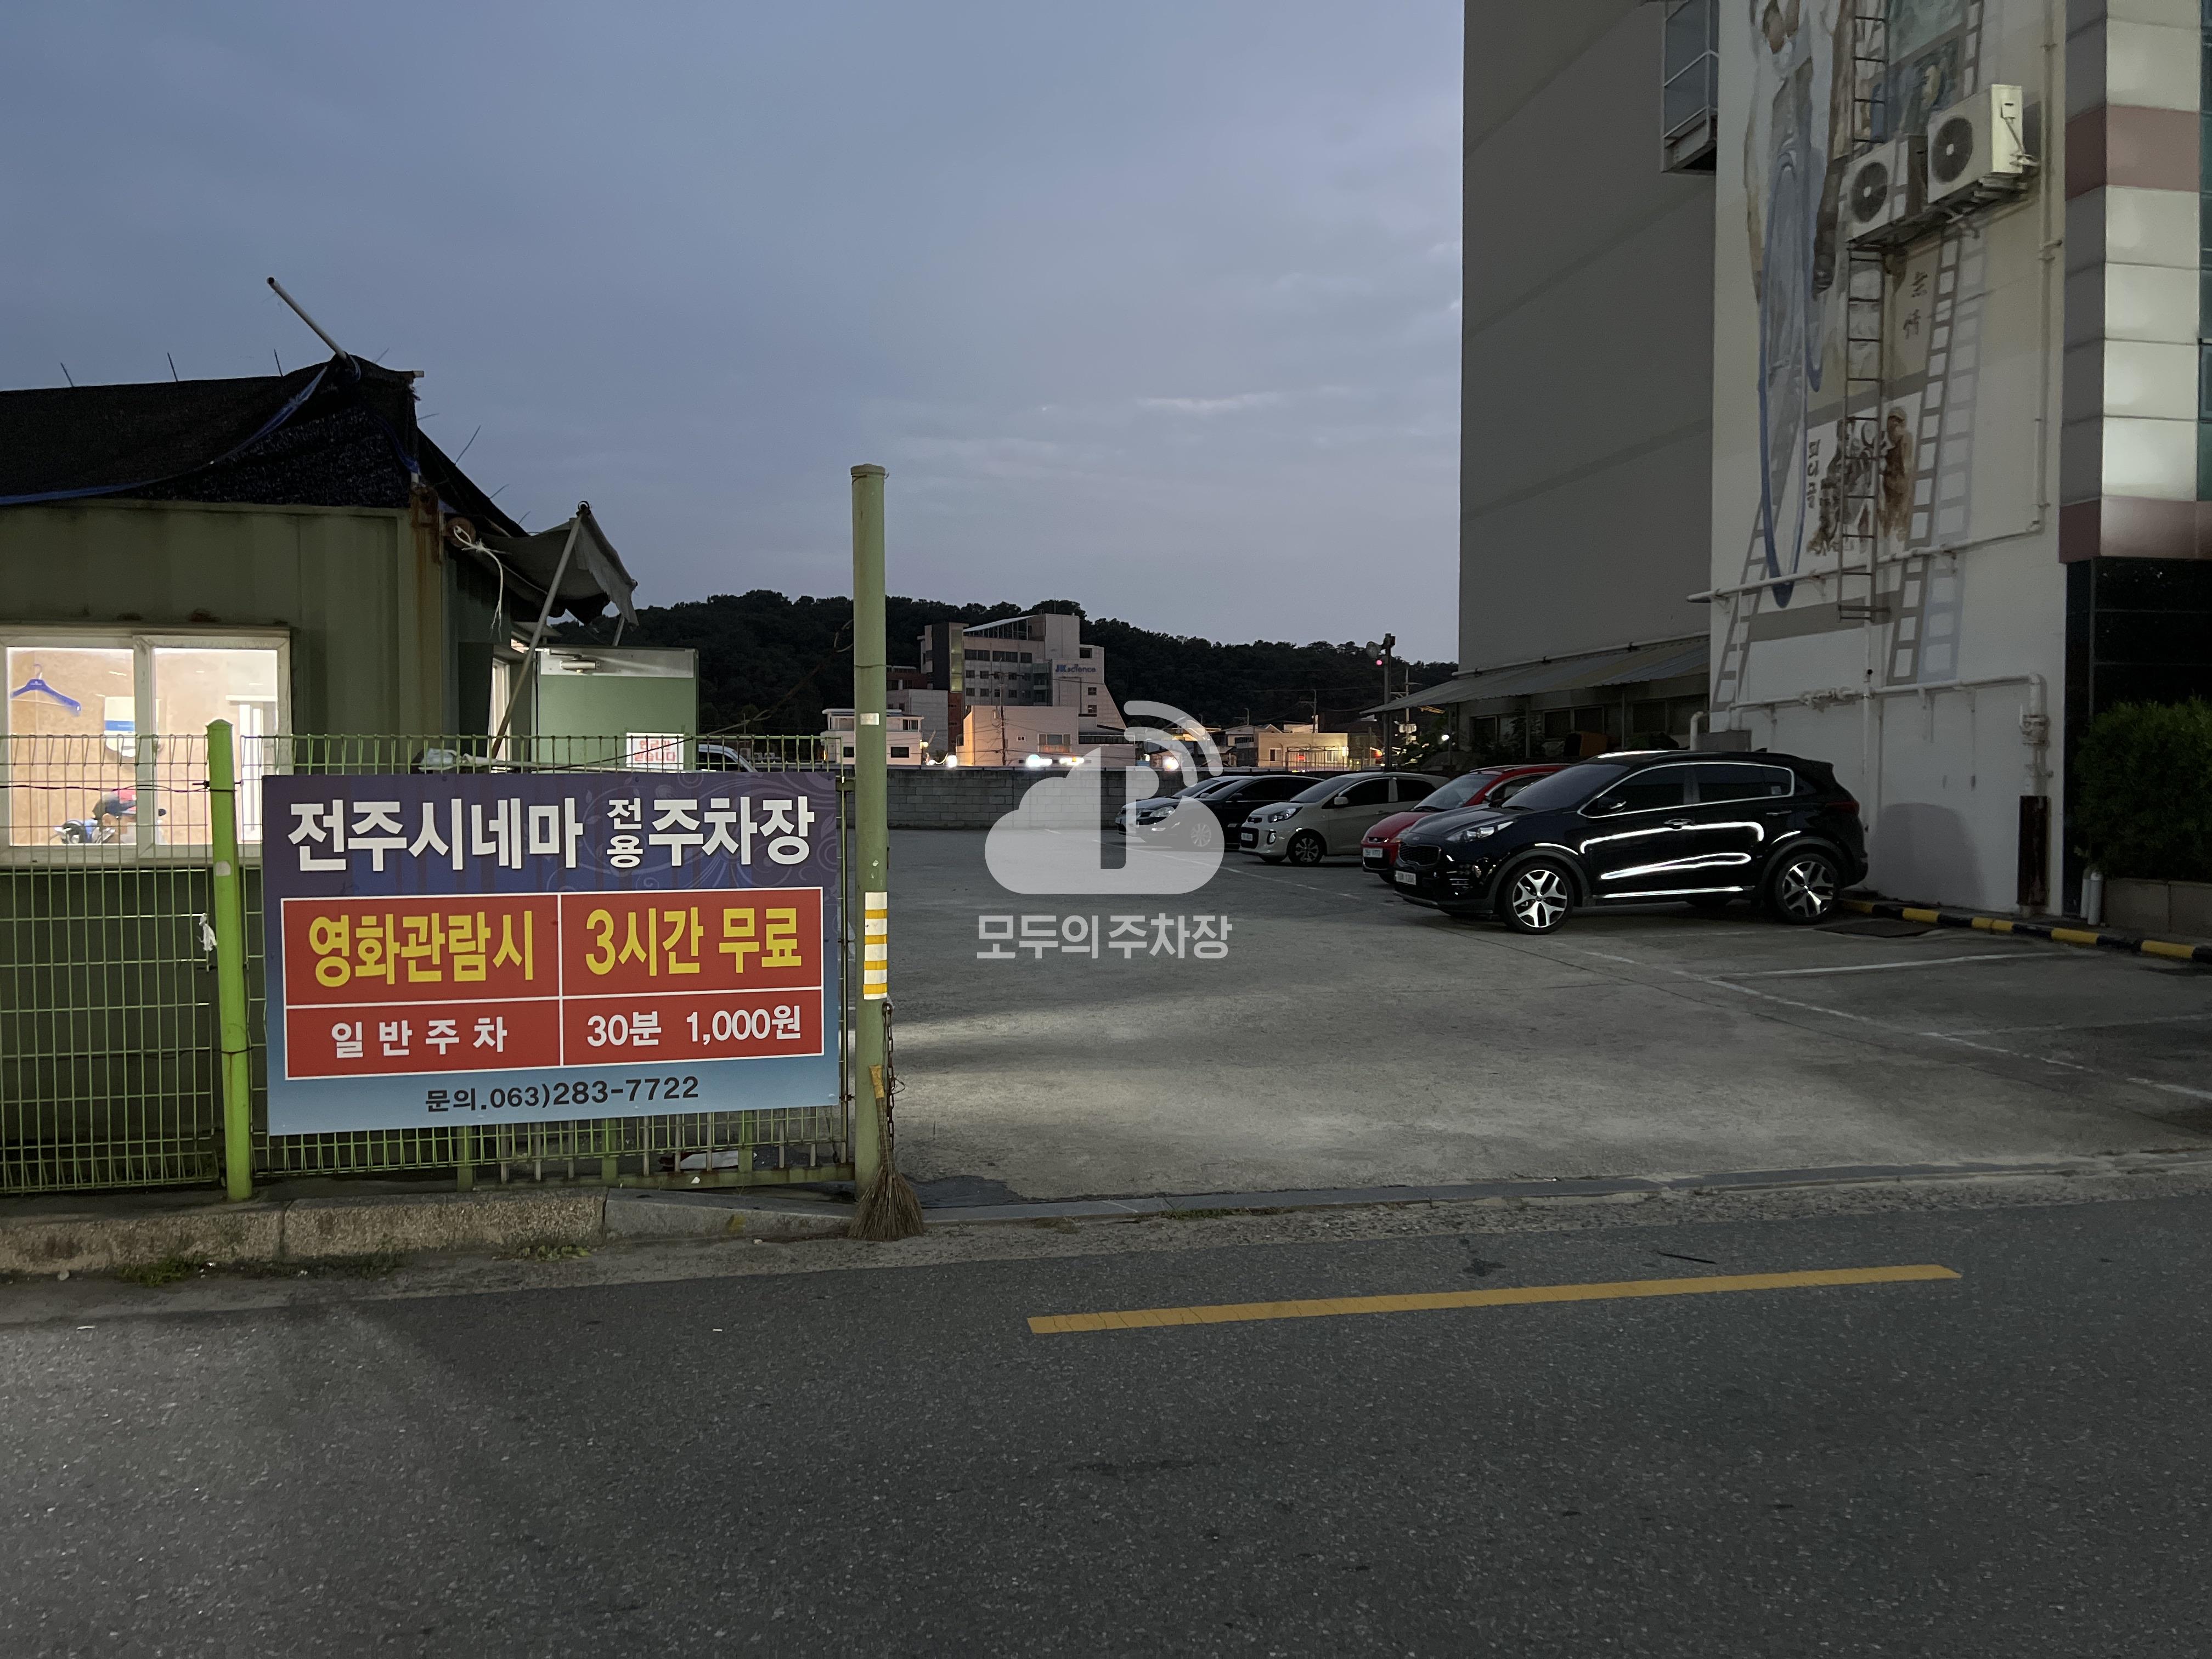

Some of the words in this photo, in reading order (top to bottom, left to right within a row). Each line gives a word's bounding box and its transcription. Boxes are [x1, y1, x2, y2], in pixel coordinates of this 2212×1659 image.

[287, 798, 583, 872] 전주시네마
[648, 796, 815, 866] 주차장
[309, 911, 533, 987] 영화관람시
[585, 907, 704, 977] 3시간
[719, 907, 802, 973] 무료
[587, 1011, 662, 1047] 30분
[686, 1005, 801, 1046] 1,000원
